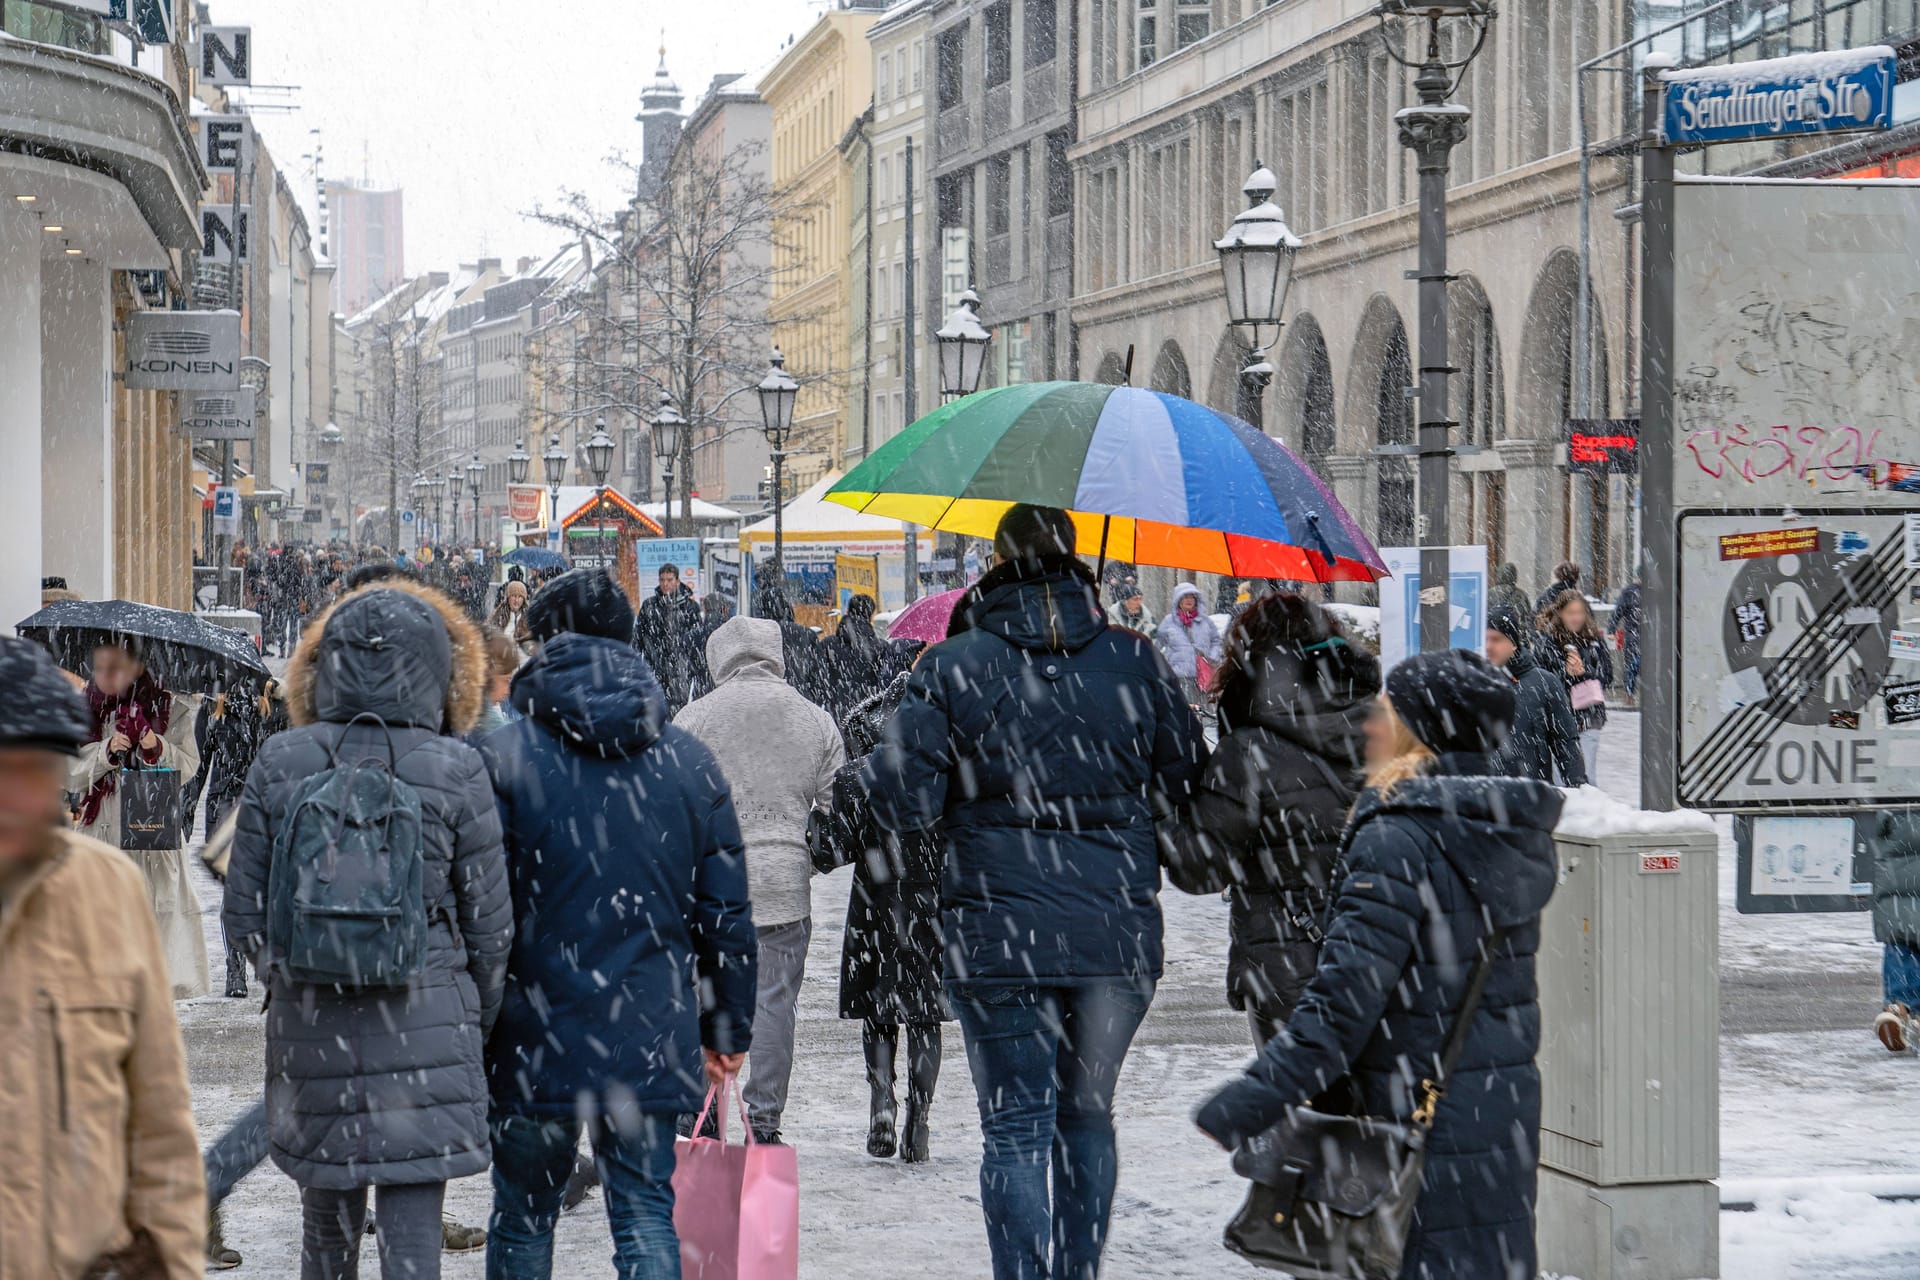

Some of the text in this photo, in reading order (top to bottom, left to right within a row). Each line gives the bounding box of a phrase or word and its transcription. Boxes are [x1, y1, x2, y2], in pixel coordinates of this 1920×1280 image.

[1680, 83, 1803, 132] Sendlinger
[129, 360, 233, 374] KONEN
[181, 418, 251, 428] KONEN
[641, 542, 695, 553] Falun Dafa
[575, 560, 593, 568] END
[1746, 739, 1877, 785] ZONE
